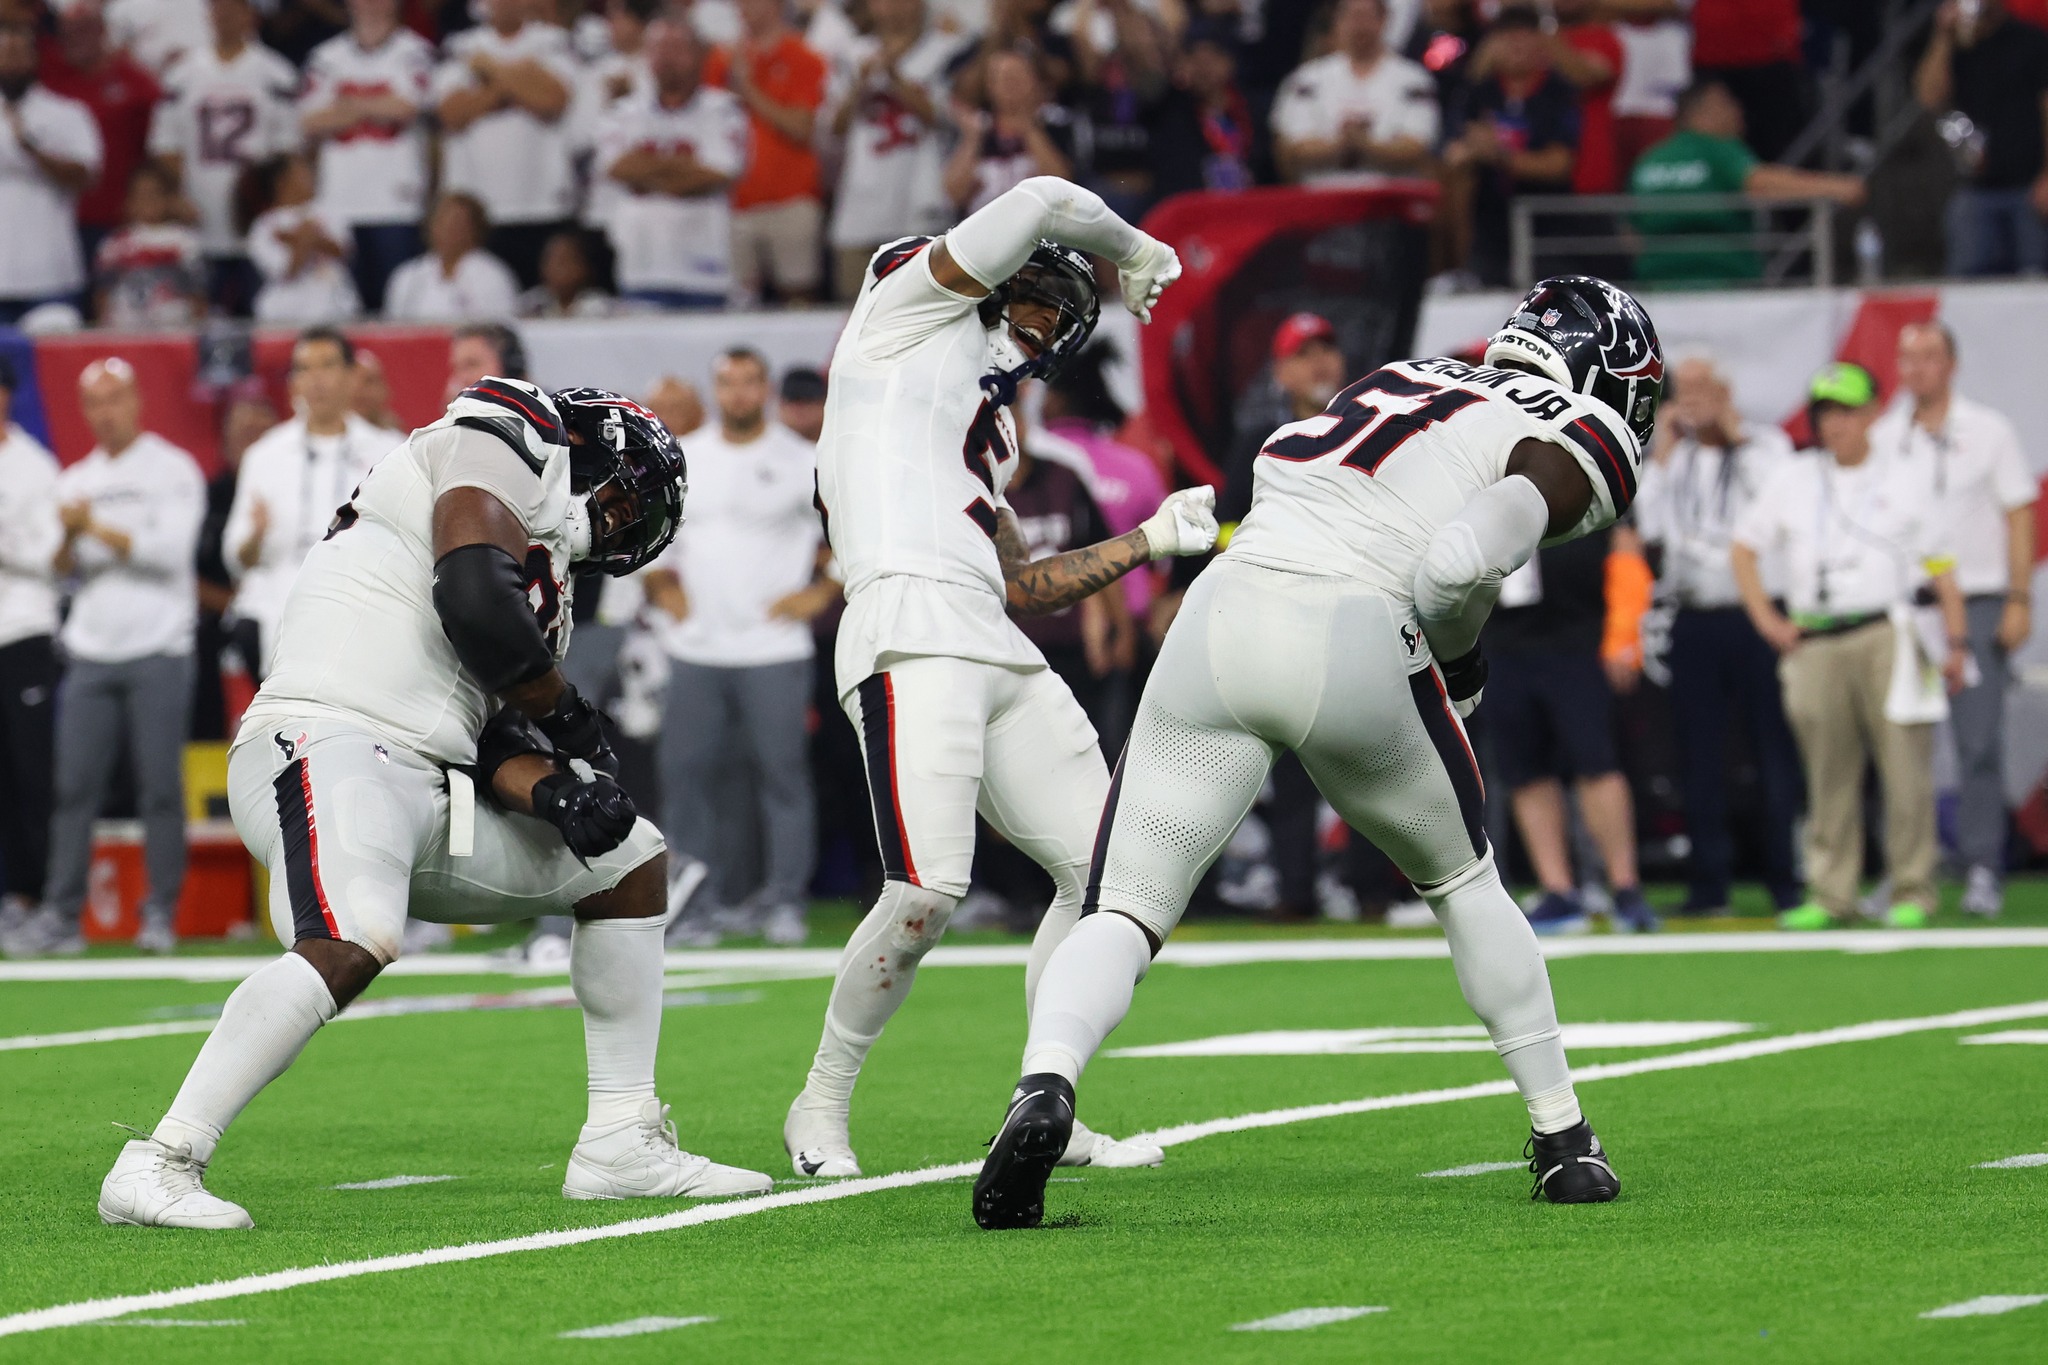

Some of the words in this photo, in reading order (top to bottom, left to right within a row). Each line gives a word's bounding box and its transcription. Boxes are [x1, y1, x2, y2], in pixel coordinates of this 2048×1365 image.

[1488, 334, 1552, 361] OUSTON
[1505, 388, 1572, 421] JR
[1259, 368, 1489, 477] 51
